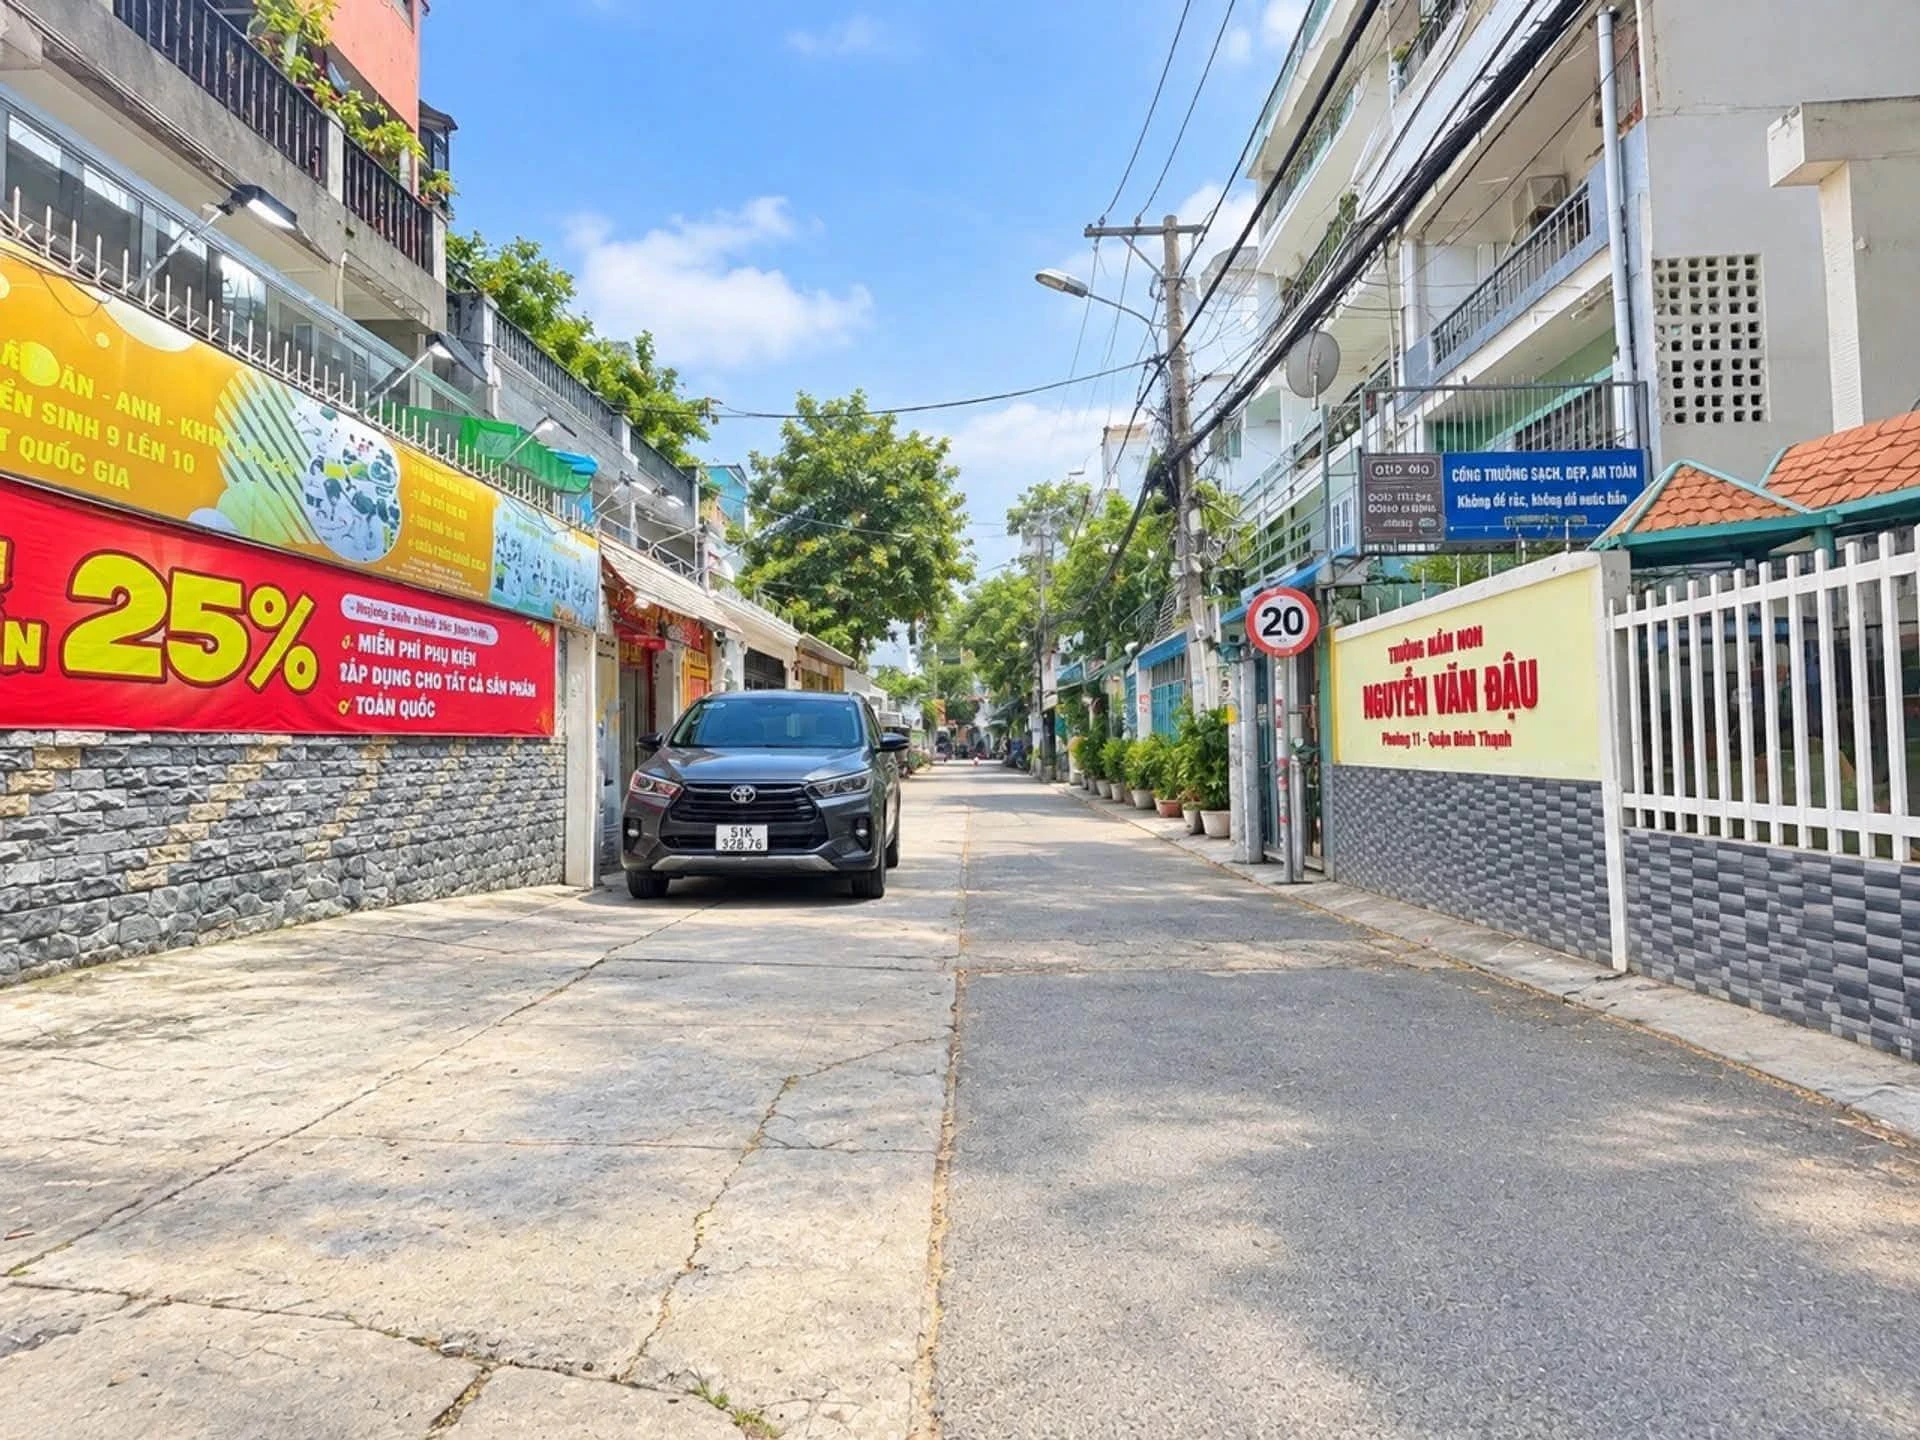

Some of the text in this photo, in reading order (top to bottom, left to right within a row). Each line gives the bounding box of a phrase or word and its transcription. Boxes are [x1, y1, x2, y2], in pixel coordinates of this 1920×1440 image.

[115, 391, 161, 426] ANH
[42, 401, 99, 440] SINH
[106, 425, 120, 448] 9
[127, 432, 165, 464] LÊN
[172, 449, 195, 473] 10
[19, 435, 86, 475] QUỐC
[93, 459, 130, 489] GIA
[1591, 466, 1607, 480] AN
[1608, 461, 1637, 479] TOÀN
[1457, 492, 1491, 510] Không
[61, 549, 319, 693] 25%
[1262, 606, 1304, 636] 20
[1457, 625, 1484, 651] NON
[372, 665, 411, 690] DỤNG
[415, 671, 442, 690] CHO
[1433, 661, 1478, 716] VĂN
[1484, 651, 1538, 721] ĐẬU
[399, 692, 436, 720] QUỐC
[1412, 731, 1421, 746] 11
[1477, 729, 1512, 750] Thạnh
[730, 826, 752, 838] 51K
